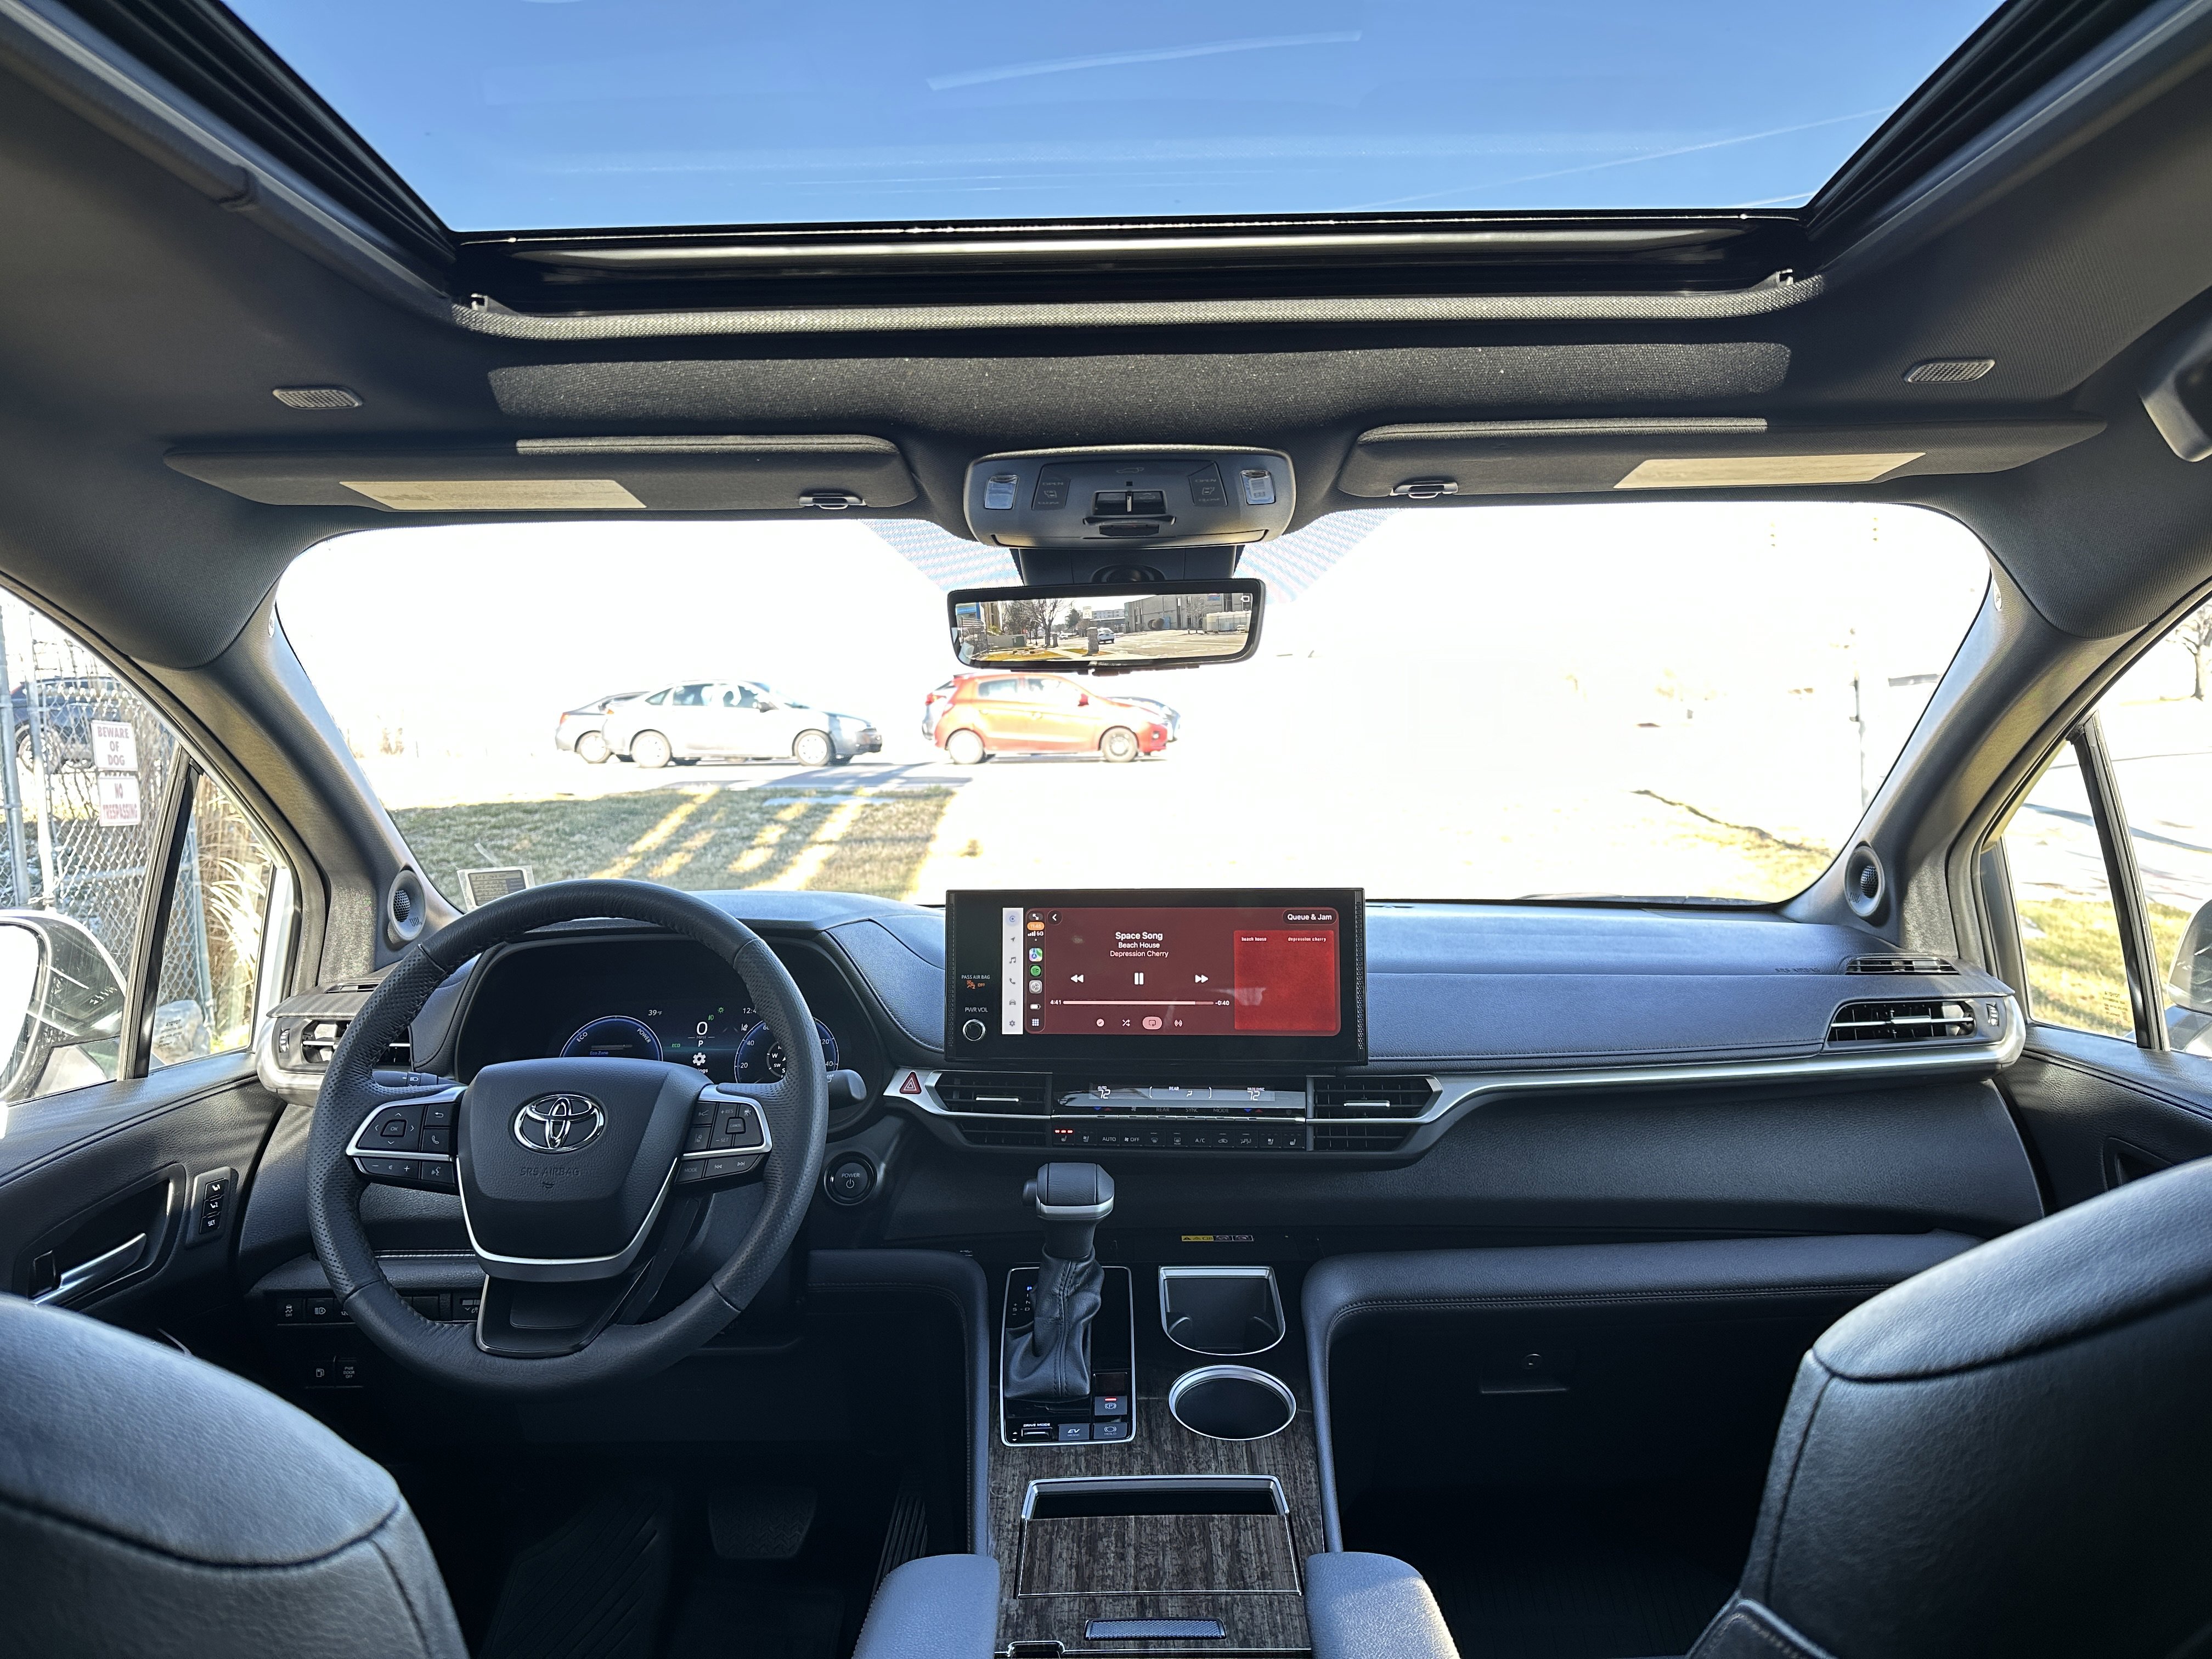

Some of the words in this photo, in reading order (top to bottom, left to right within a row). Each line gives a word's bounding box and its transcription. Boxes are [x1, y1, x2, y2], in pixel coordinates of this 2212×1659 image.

[97, 726, 129, 738] BEWARE
[110, 741, 119, 752] OF
[108, 754, 125, 765] DOG
[114, 783, 123, 799] NO
[103, 803, 137, 819] TRESPASSING
[1115, 932, 1141, 941] Space
[1142, 932, 1163, 941] Song
[696, 1021, 708, 1035] 0
[577, 1031, 588, 1042] ECO
[636, 1028, 651, 1043] POWER
[1098, 1089, 1110, 1099] 72
[1247, 1091, 1260, 1101] 72
[520, 1167, 539, 1176] SRS
[542, 1167, 580, 1177] AIRBAG
